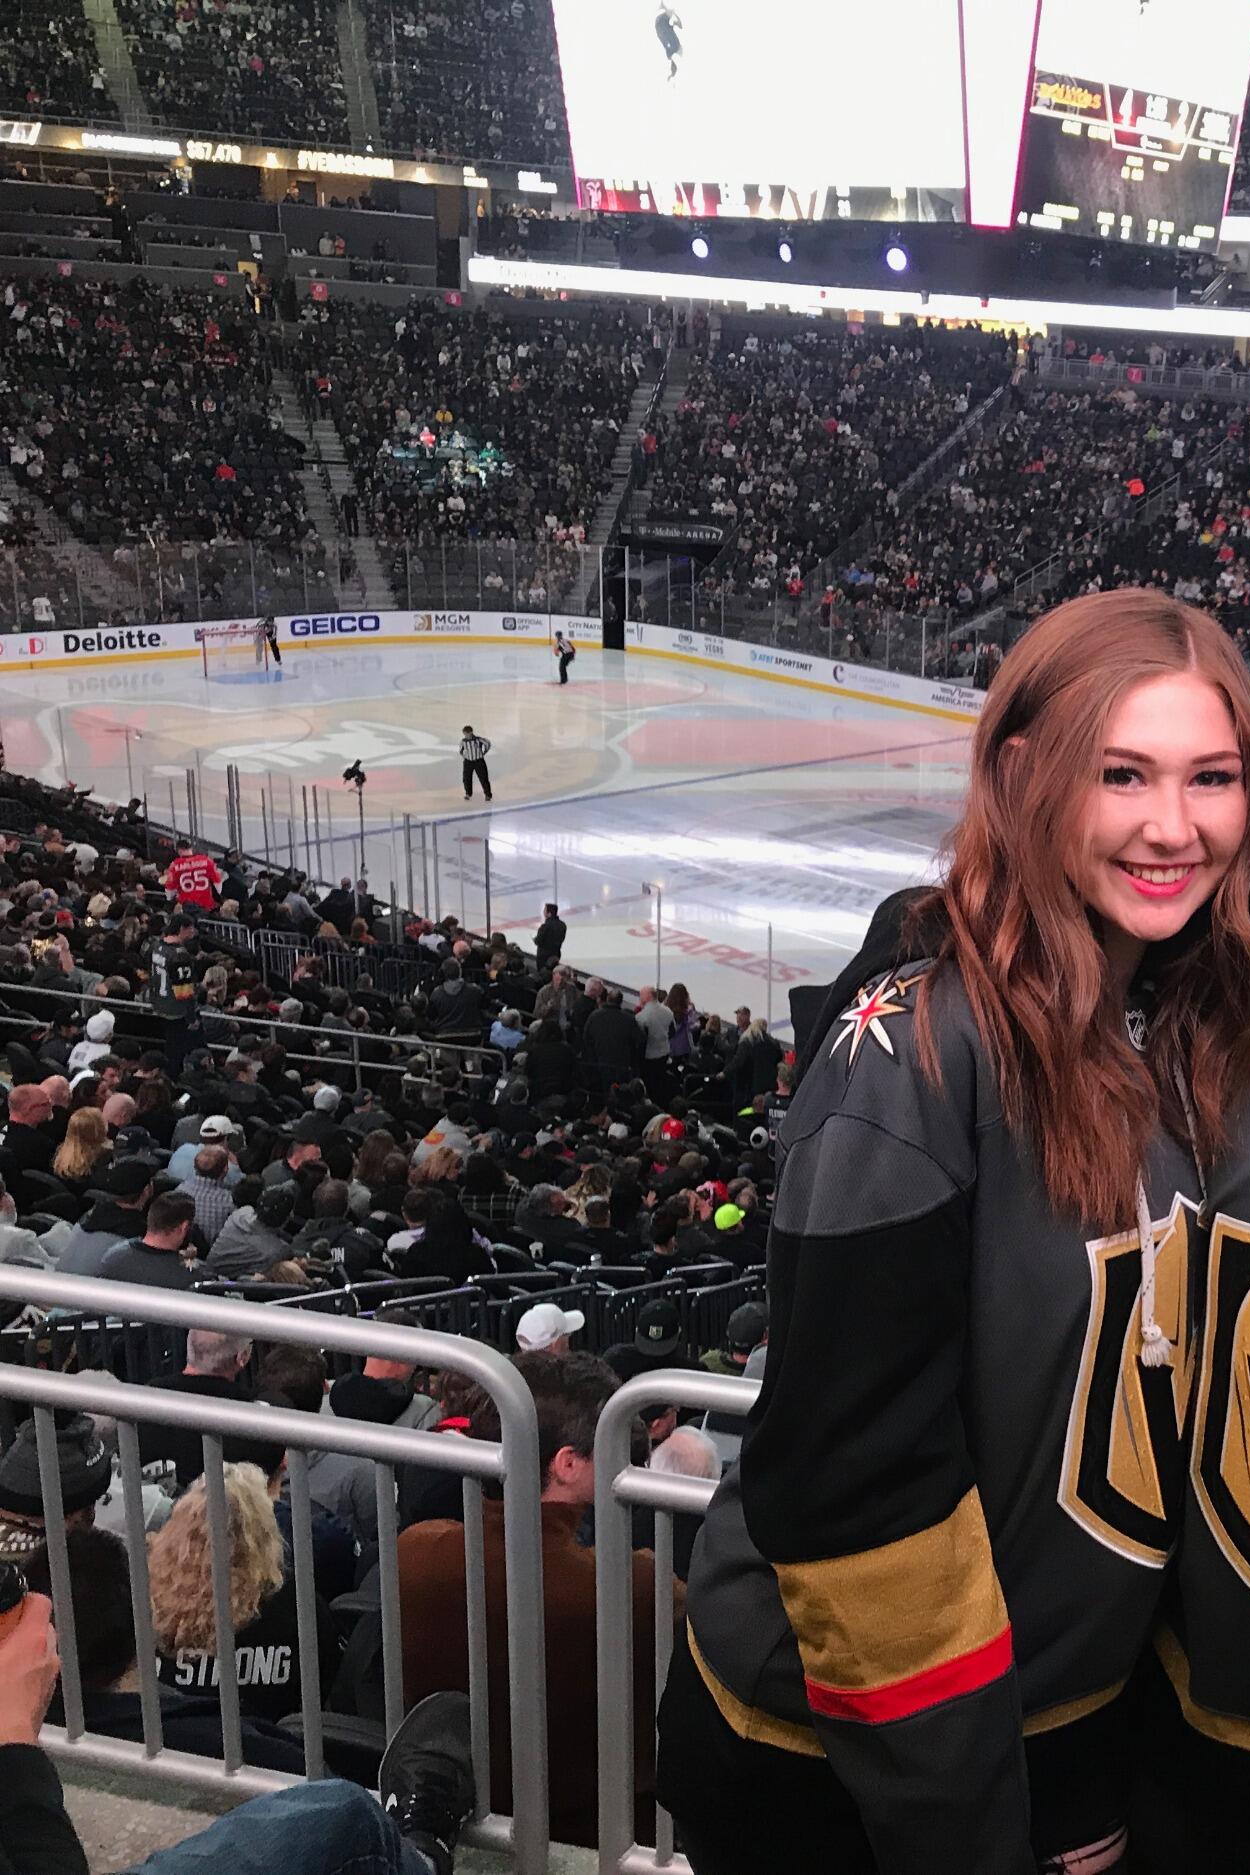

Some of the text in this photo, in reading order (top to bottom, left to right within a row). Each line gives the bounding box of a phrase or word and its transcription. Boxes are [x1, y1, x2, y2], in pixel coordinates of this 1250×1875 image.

[290, 615, 380, 636] GEICO
[434, 614, 470, 625] MGM
[63, 630, 161, 654] Deloitte
[180, 870, 209, 892] 65
